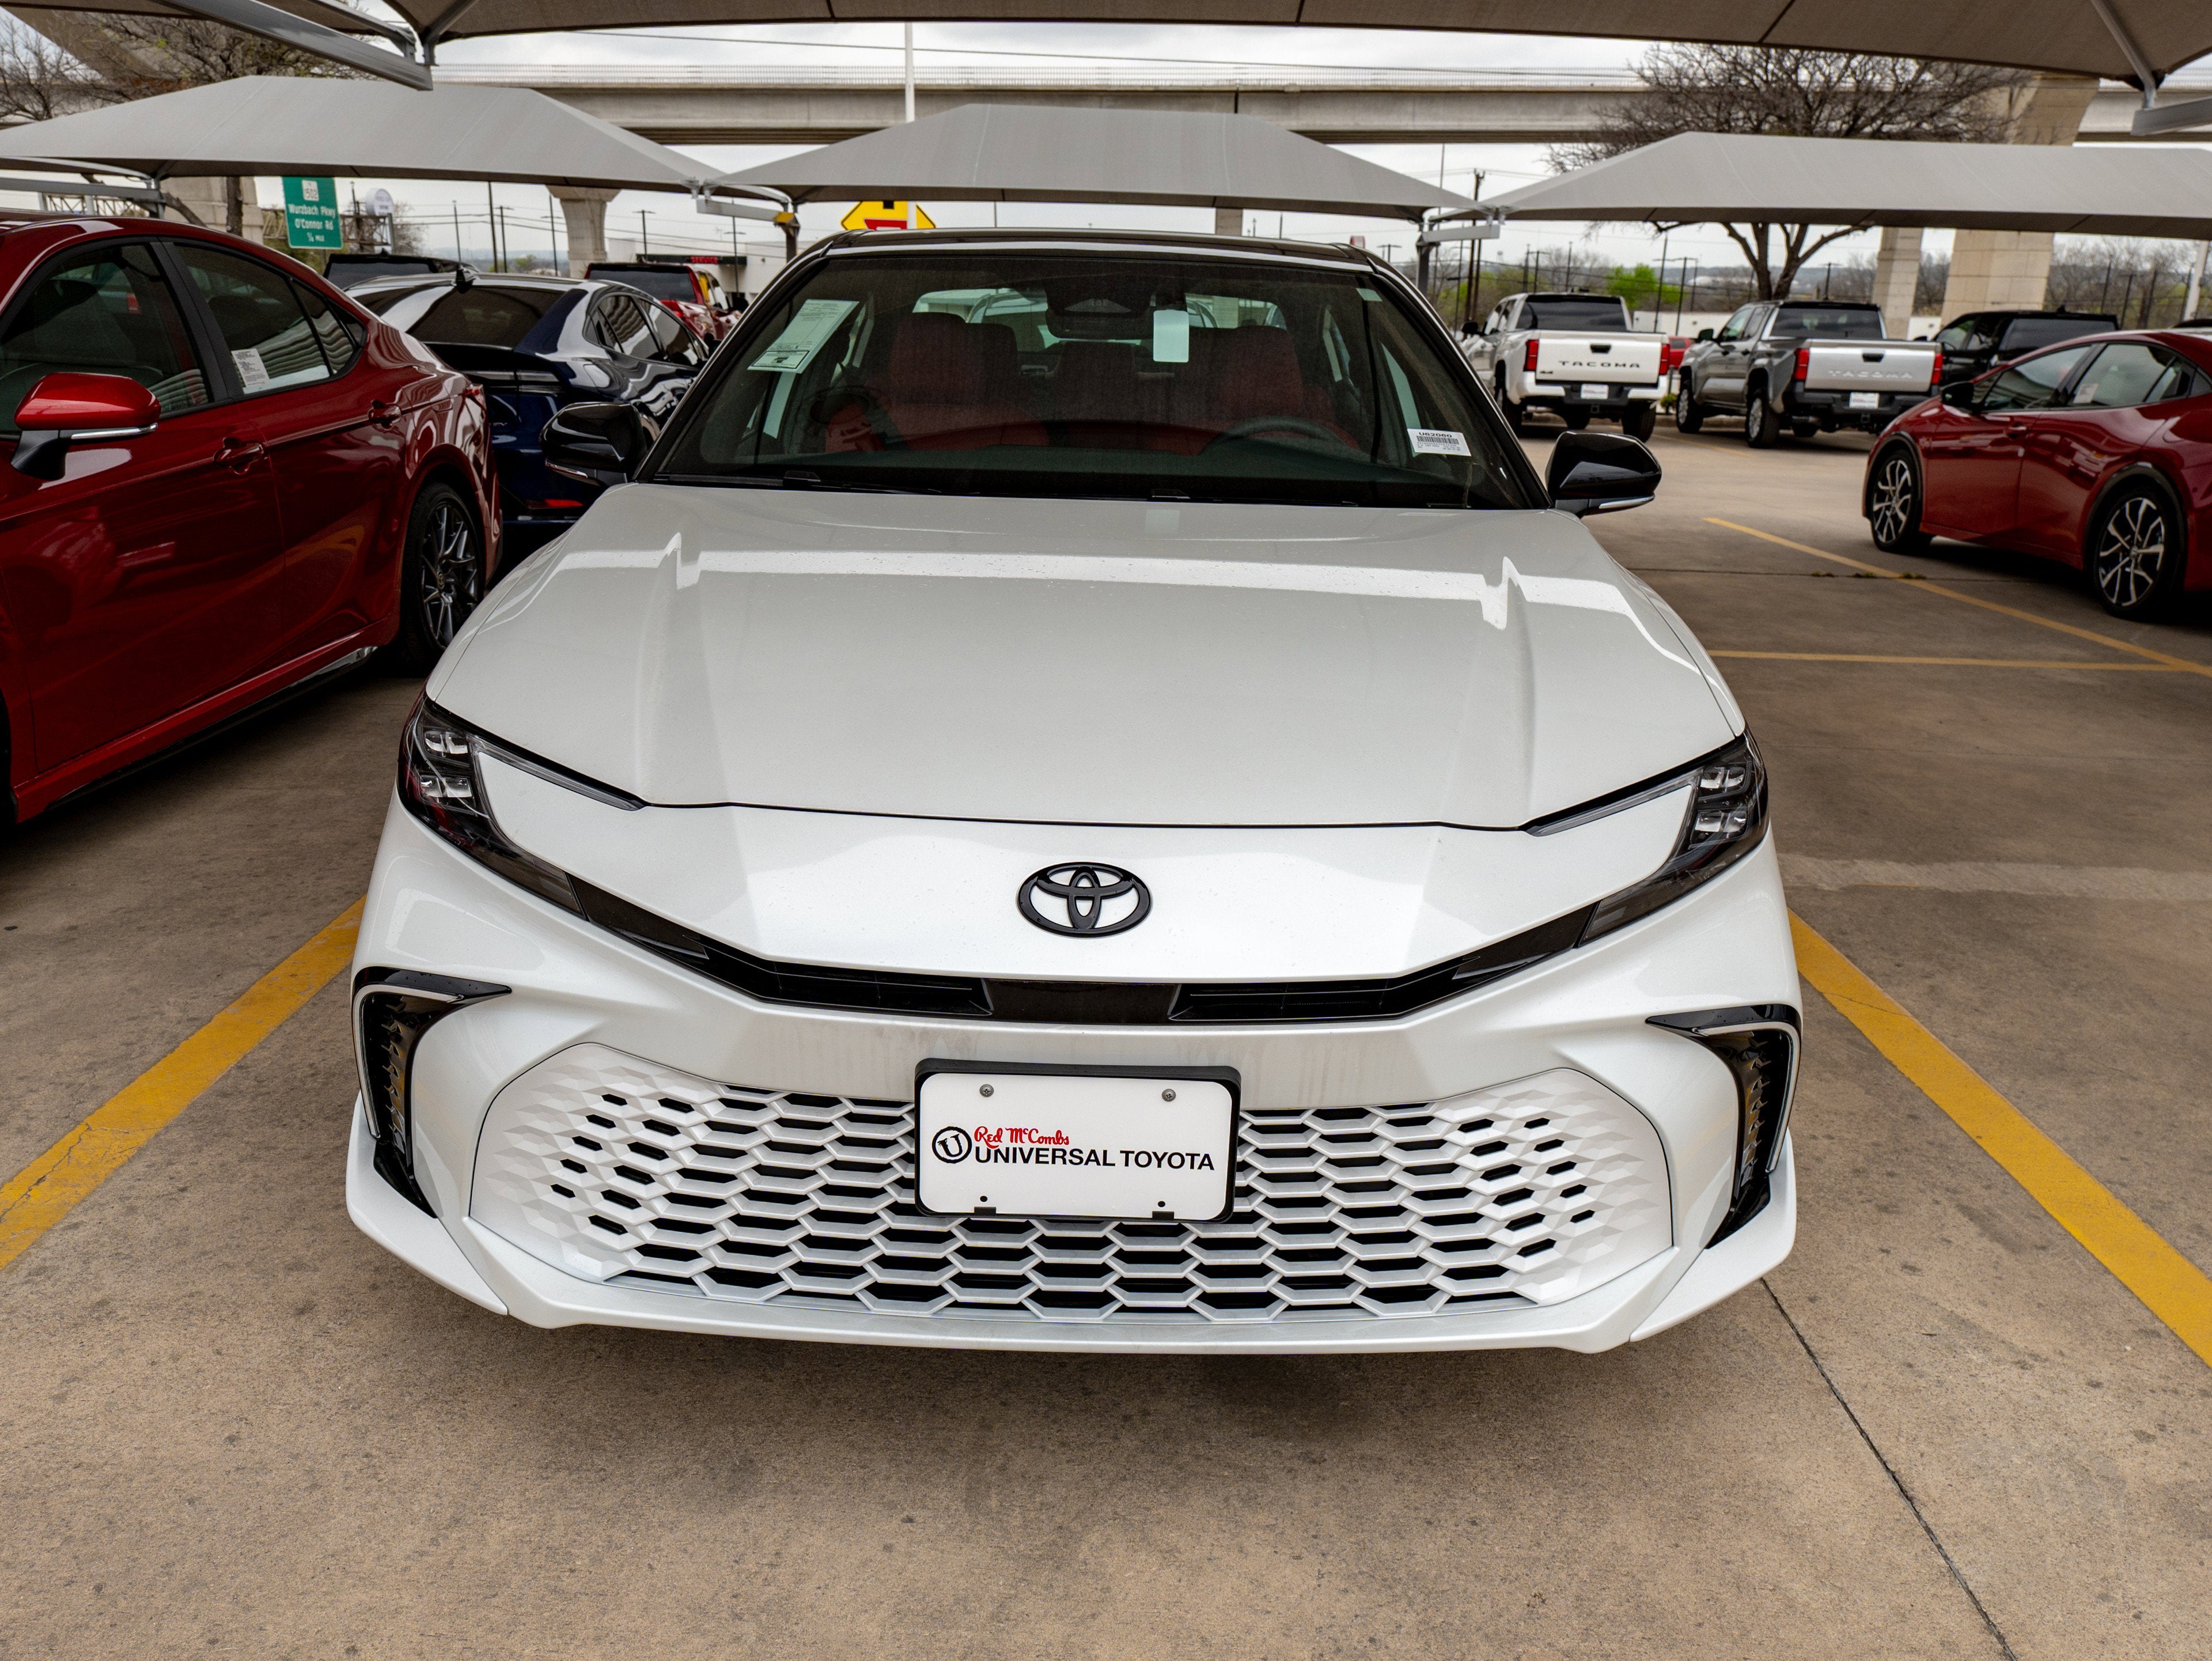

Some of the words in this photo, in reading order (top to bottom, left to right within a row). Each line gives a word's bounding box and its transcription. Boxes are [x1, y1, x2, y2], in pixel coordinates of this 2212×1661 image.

[288, 203, 319, 215] Wurzbach
[321, 206, 336, 218] Pkwy
[294, 218, 323, 229] O'Connor
[325, 220, 334, 230] Rd
[1828, 370, 1912, 379] TACOMA
[974, 1126, 1003, 1149] Red
[1005, 1127, 1070, 1145] McCombs
[975, 1146, 1116, 1167] UNIVERSAL
[1119, 1150, 1215, 1171] TOYOTA
